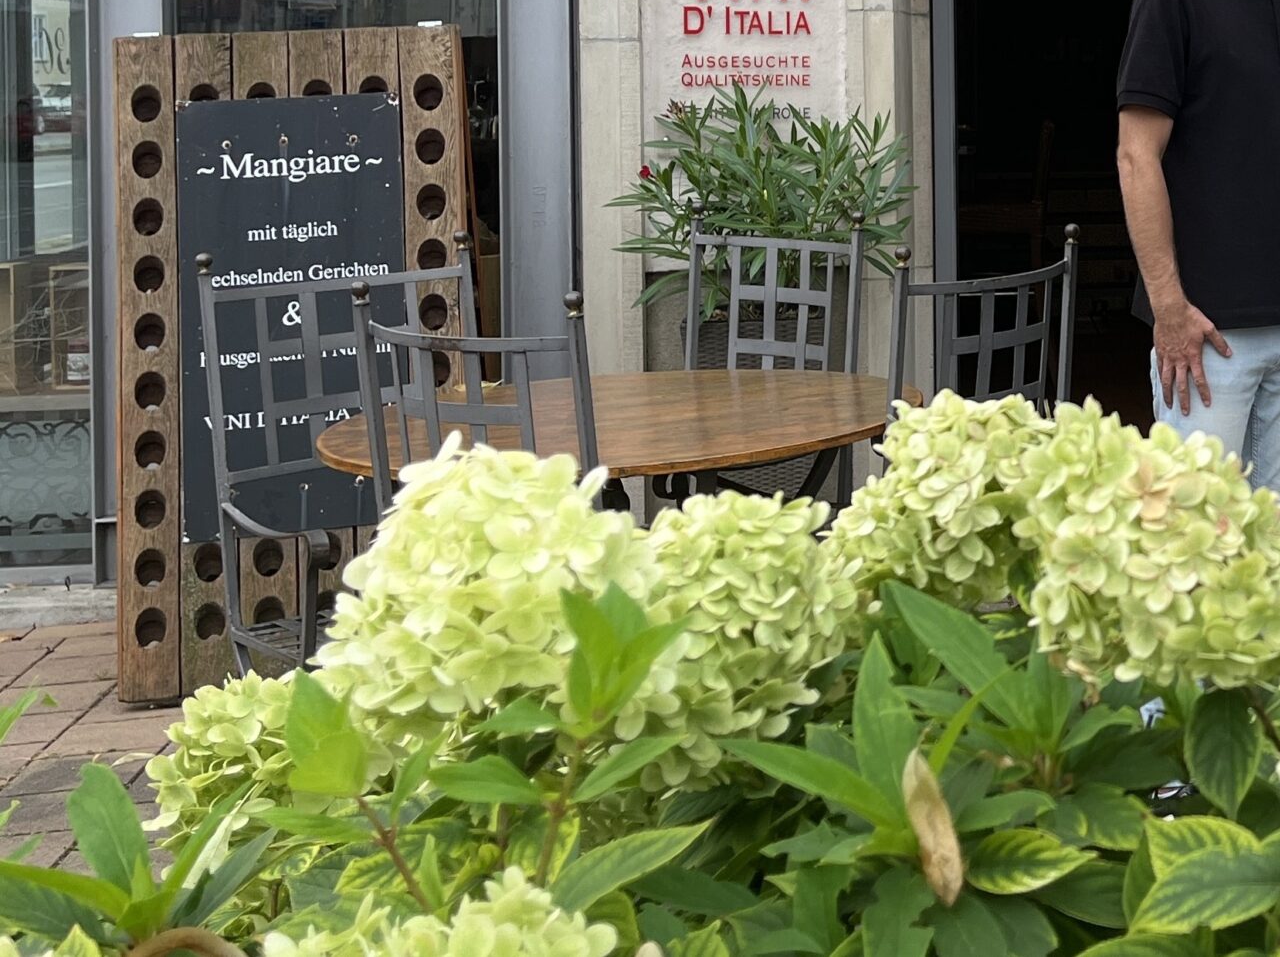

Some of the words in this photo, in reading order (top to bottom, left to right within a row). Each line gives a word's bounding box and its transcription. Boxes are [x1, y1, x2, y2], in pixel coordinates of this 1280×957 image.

[681, 54, 811, 68] AUSGESUCHTE
[681, 71, 811, 88] QUALITÄTSWEINE
[220, 149, 360, 182] Mangiare
[247, 224, 277, 242] mit
[282, 221, 338, 242] täglich
[210, 266, 304, 287] echselnden
[308, 262, 389, 281] Gerichten
[282, 301, 302, 326] &
